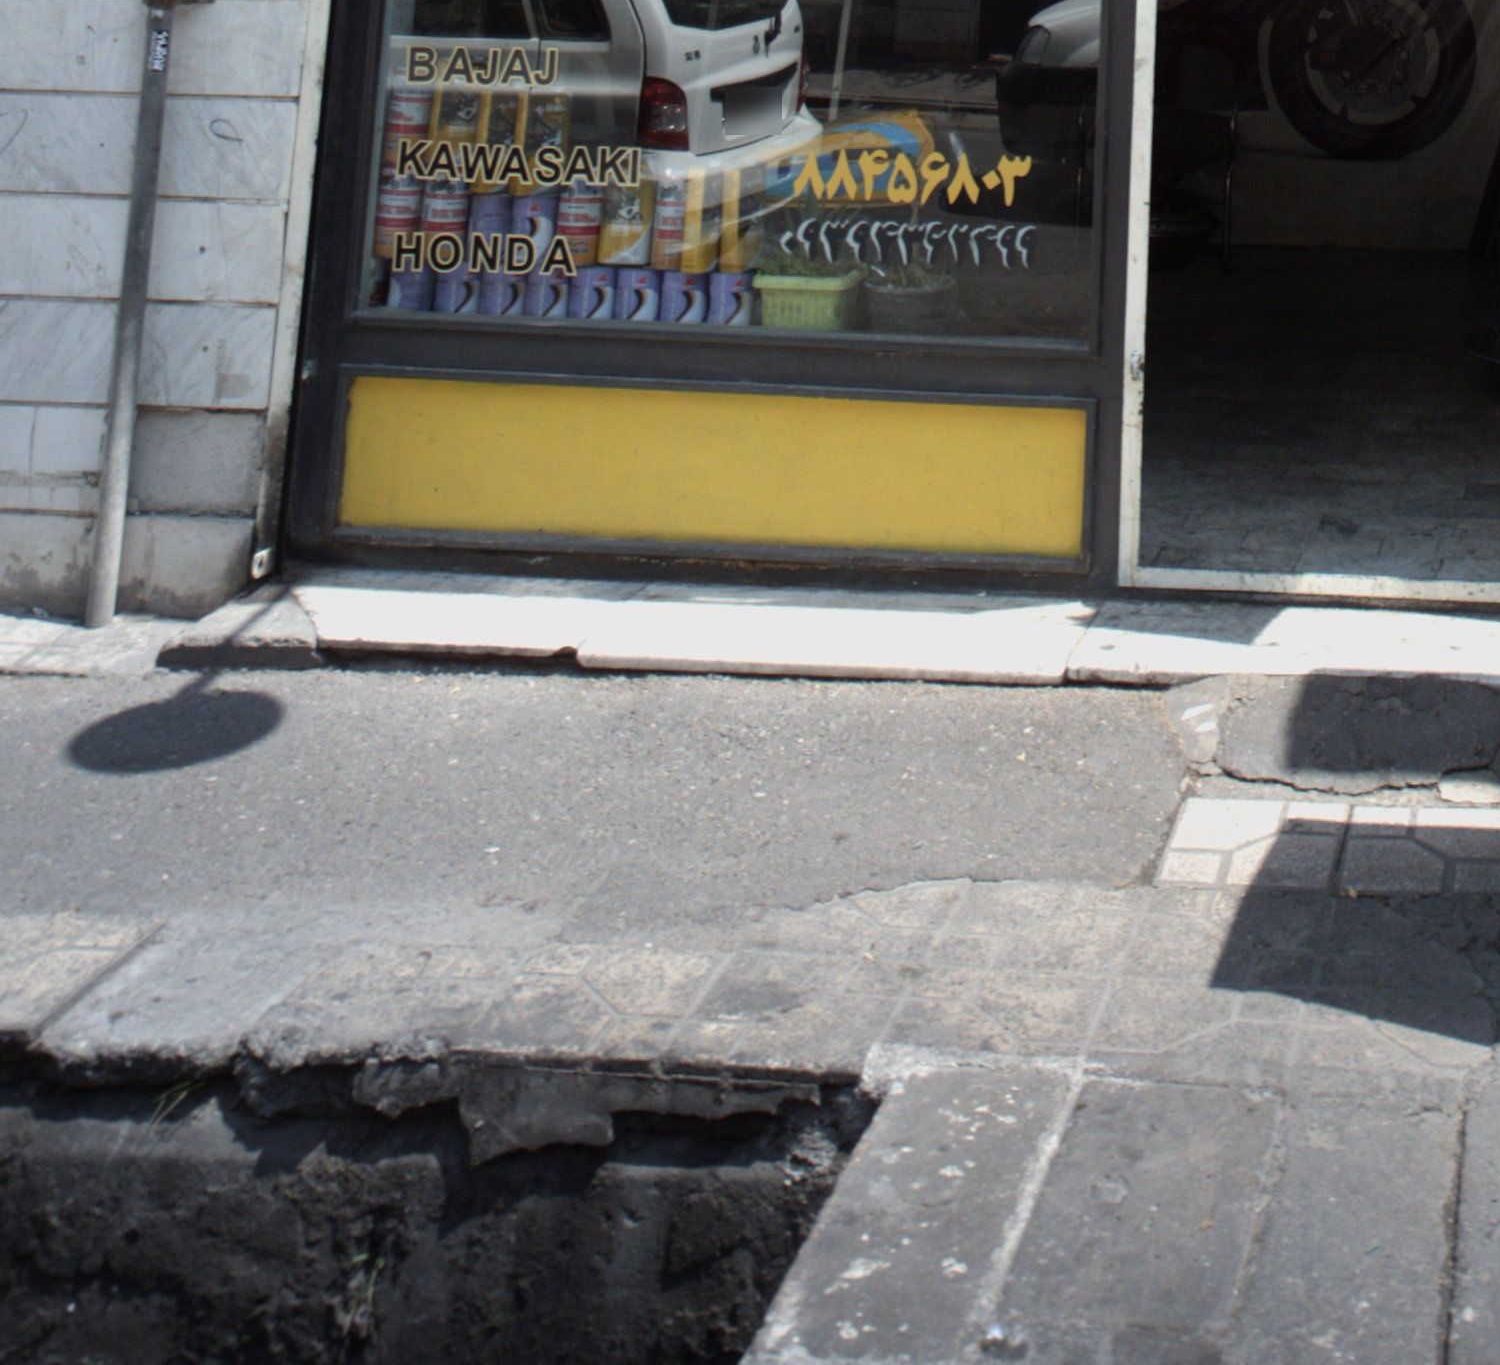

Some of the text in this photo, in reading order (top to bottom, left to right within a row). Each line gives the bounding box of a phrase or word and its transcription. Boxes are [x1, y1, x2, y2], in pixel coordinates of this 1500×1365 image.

[406, 46, 559, 85] BAJAJ
[397, 139, 642, 186] KAWASAKI
[793, 149, 1033, 206] ۸۸۴۵۶۸۰۳
[392, 232, 577, 276] HONDA
